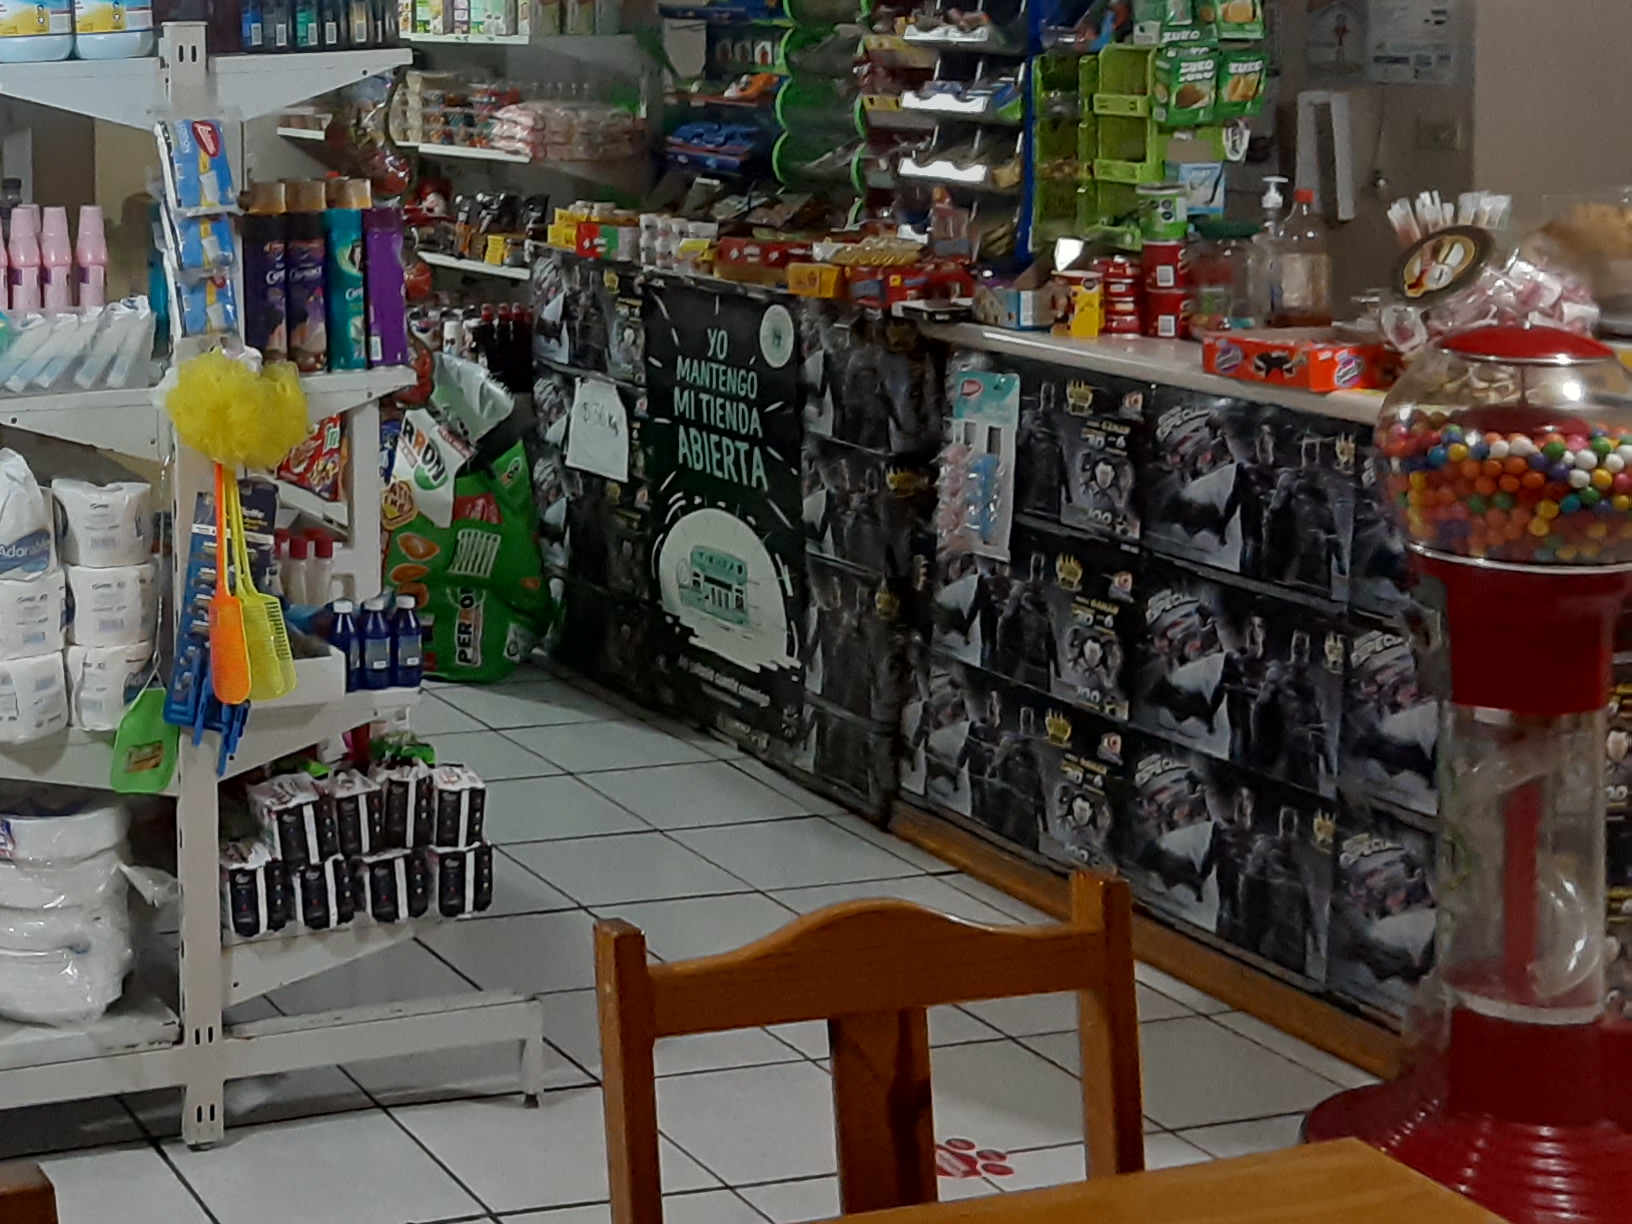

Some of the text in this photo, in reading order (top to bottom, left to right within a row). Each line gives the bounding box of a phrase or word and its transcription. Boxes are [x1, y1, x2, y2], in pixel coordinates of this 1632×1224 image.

[706, 328, 729, 361] YO
[676, 354, 759, 401] MANTENGO
[673, 386, 764, 440] MI TIENDA
[677, 424, 769, 492] ABIERTA
